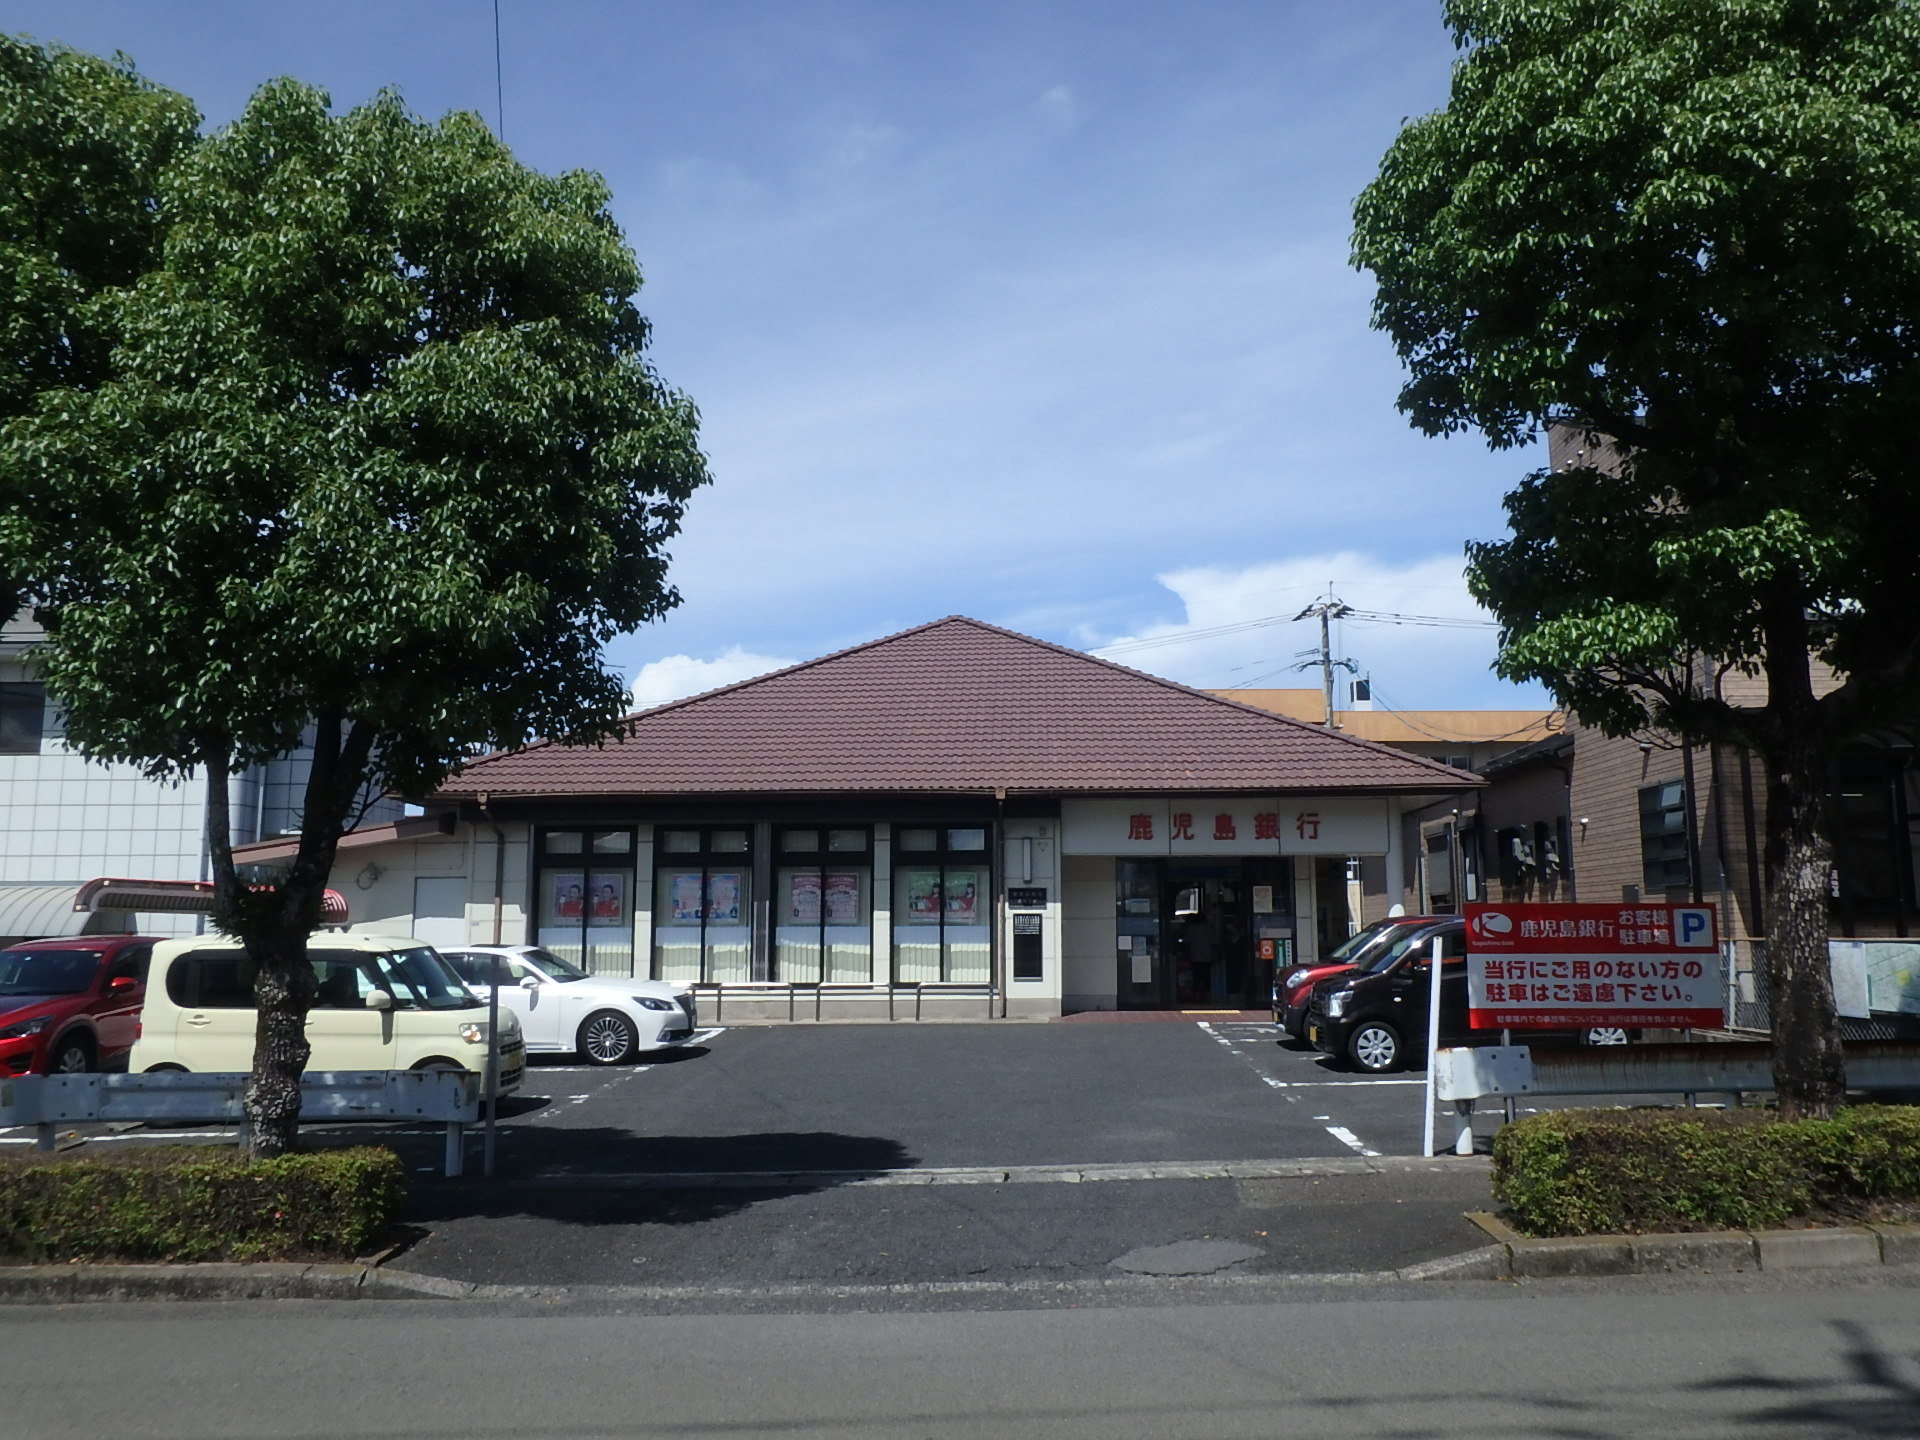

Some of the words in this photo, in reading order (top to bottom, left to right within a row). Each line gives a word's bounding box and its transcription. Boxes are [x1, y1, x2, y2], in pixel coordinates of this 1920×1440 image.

[1128, 812, 1321, 841] 鹿児島銀行
[1619, 909, 1669, 926] お客様
[1682, 912, 1705, 943] P
[1520, 919, 1616, 939] 鹿児島銀行
[1619, 928, 1670, 945] 駐車場
[1484, 960, 1703, 980] 当行にご用のない方の
[1485, 982, 1694, 1003] 駐車はご遠慮下さい。
